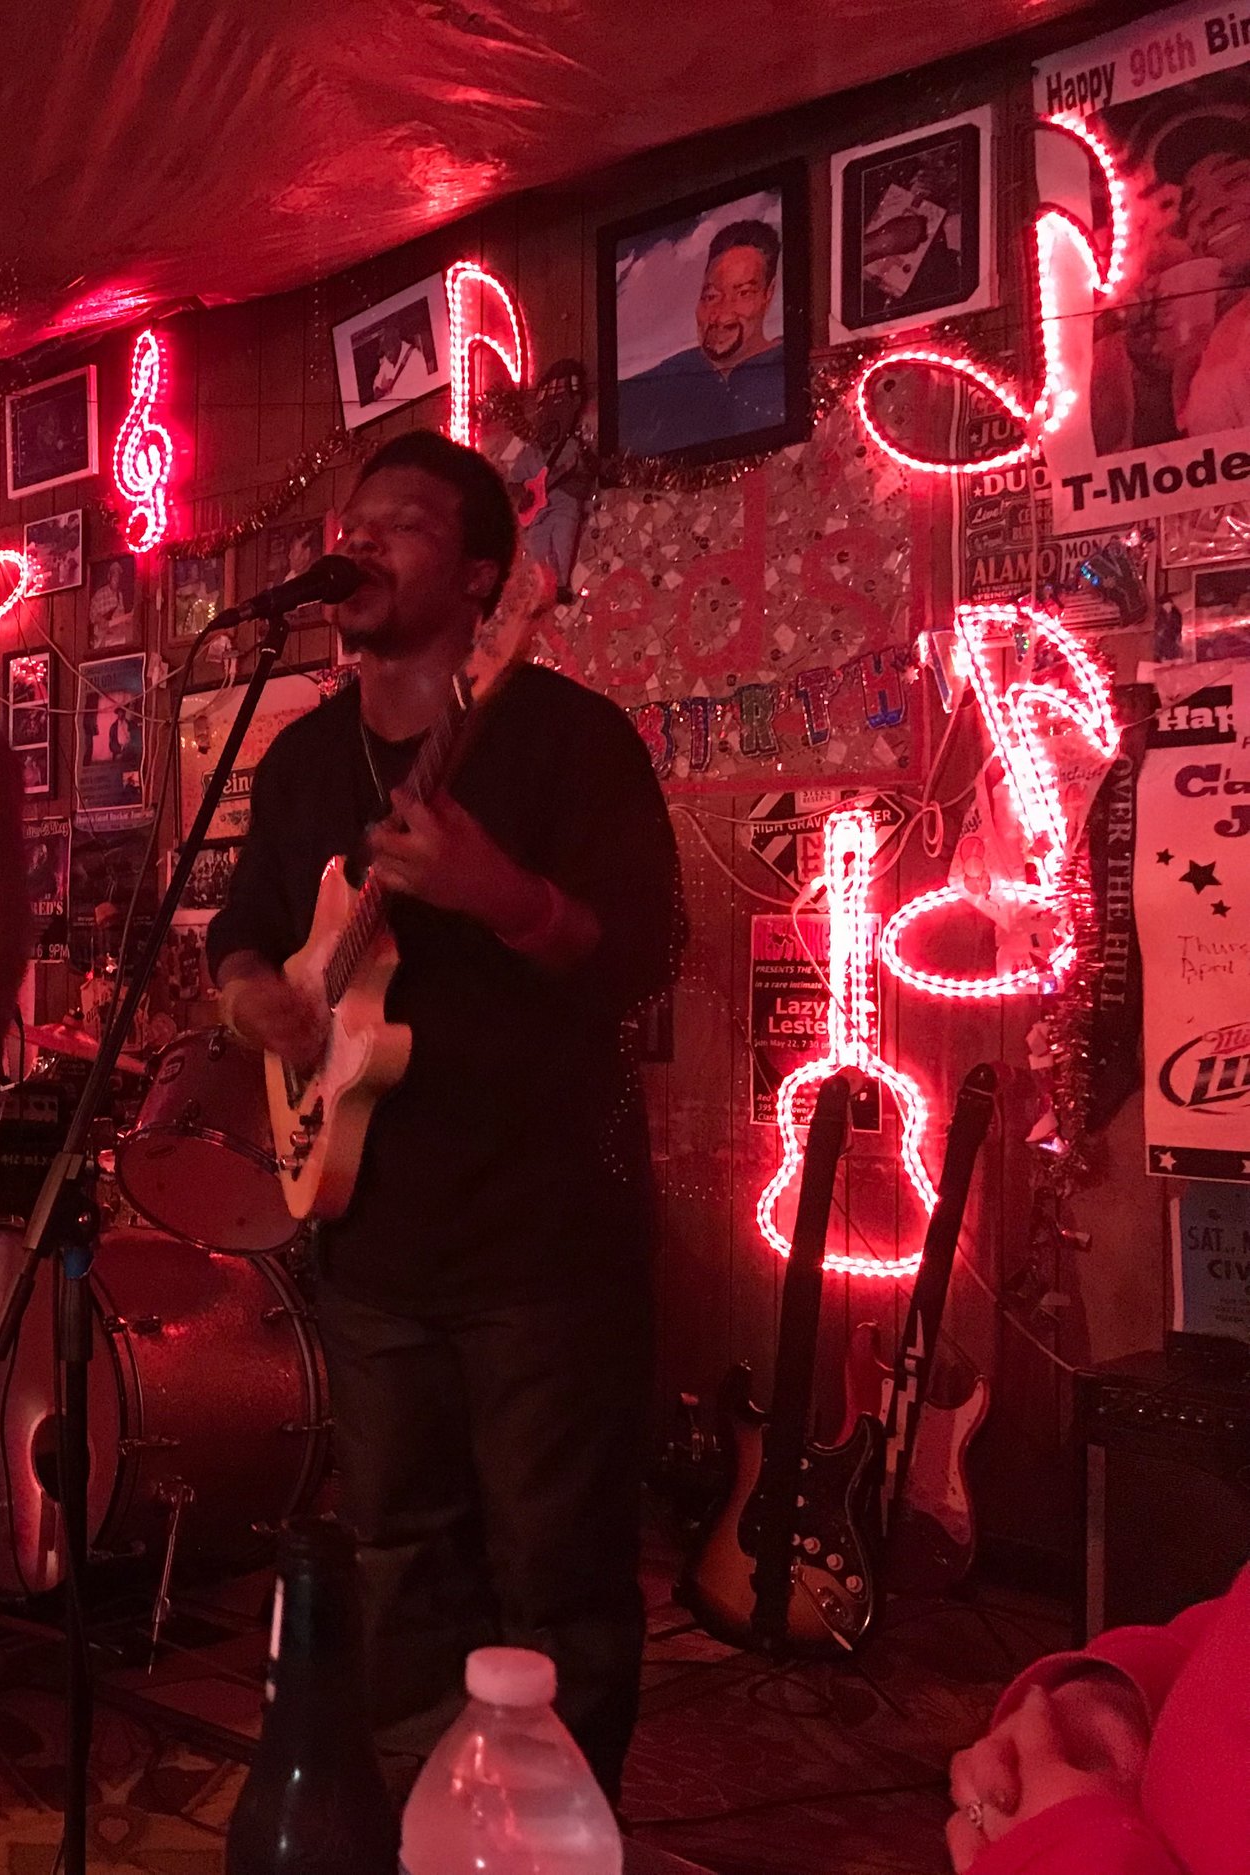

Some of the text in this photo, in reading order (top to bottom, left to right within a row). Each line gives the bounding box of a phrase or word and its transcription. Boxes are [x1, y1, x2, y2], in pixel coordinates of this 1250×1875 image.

[1046, 62, 1116, 116] Happy
[1130, 33, 1196, 87] 90th
[983, 466, 1052, 496] DUO
[1062, 448, 1250, 511] T-Mode
[972, 549, 1056, 586] ALAMO
[752, 809, 892, 834] HIGH GRAVI GER
[1100, 755, 1133, 1005] OVER THE HILL
[789, 981, 822, 989] intimate
[776, 997, 826, 1019] Lazy
[769, 1016, 829, 1034] Leste
